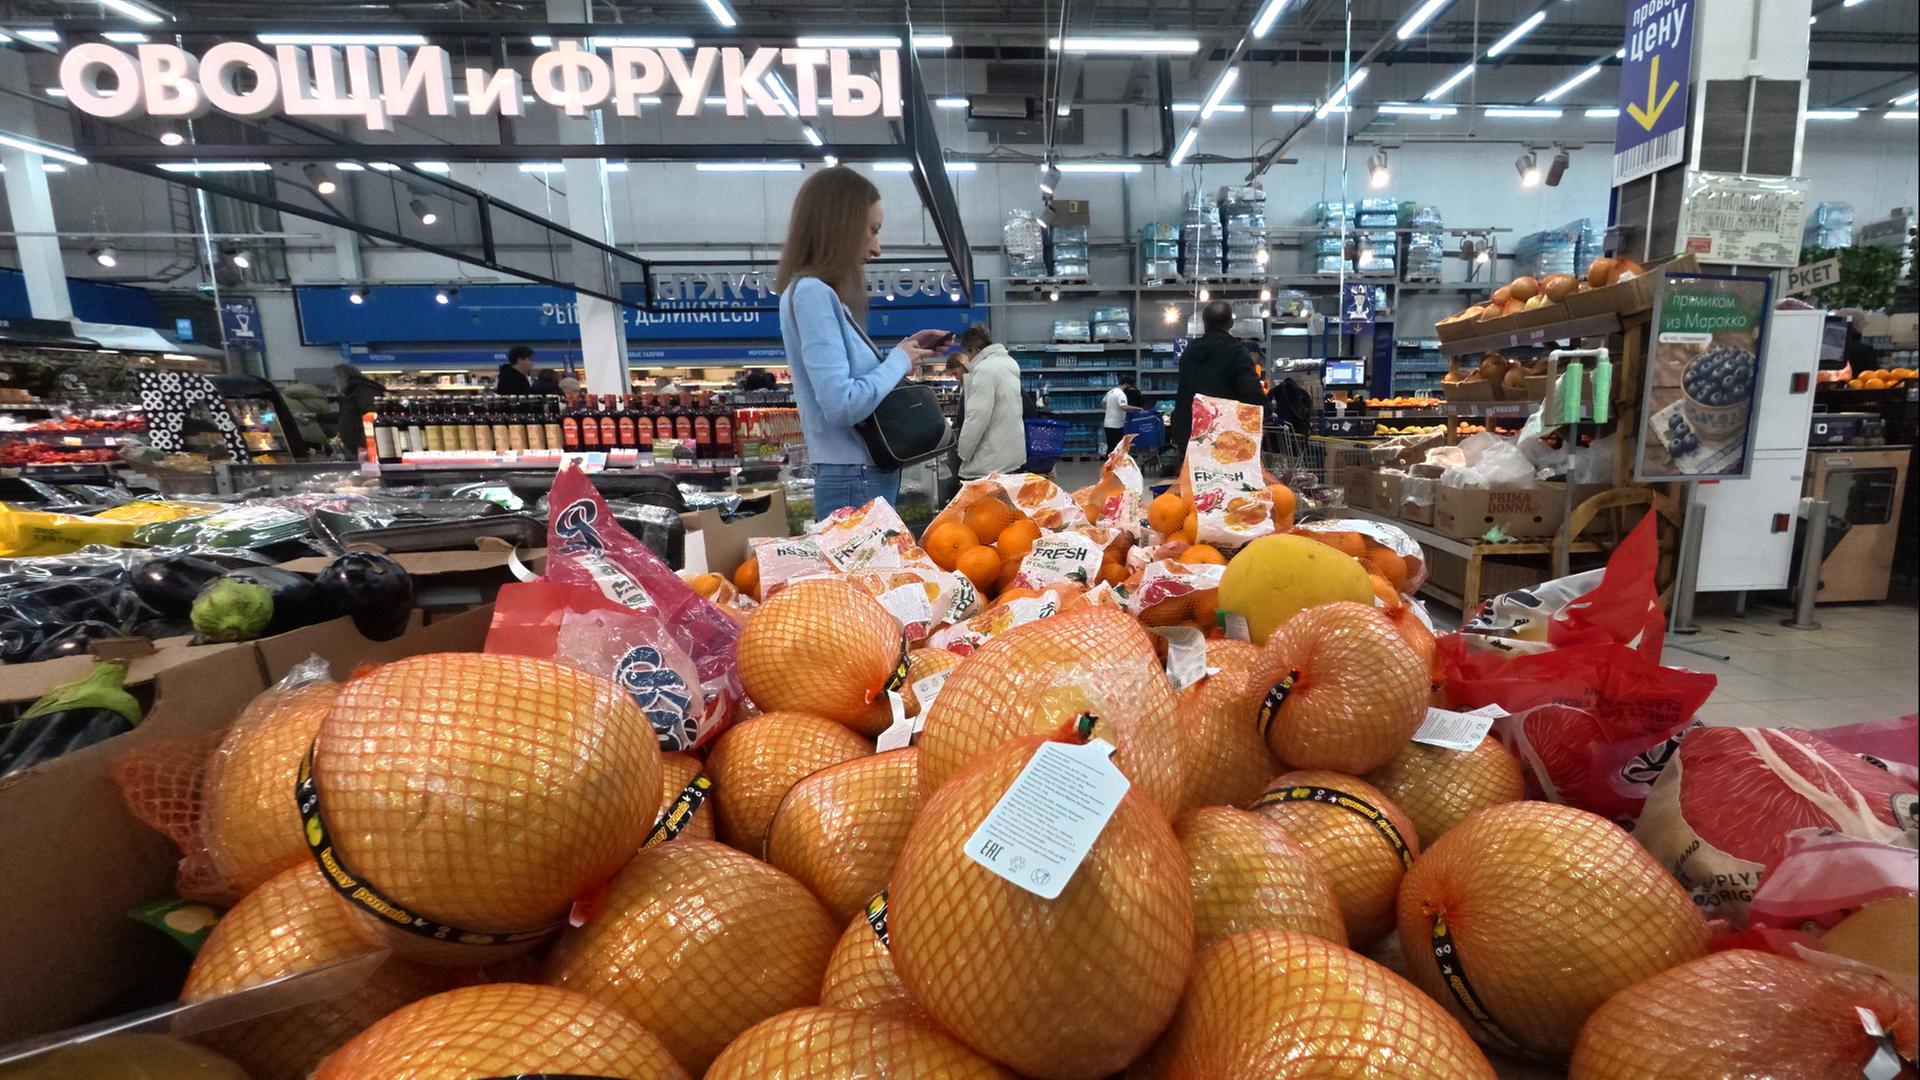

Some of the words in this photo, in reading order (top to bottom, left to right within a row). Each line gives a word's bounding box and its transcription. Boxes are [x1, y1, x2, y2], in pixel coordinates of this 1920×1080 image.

[1630, 3, 1687, 61] цену
[59, 42, 450, 131] ОВОЩИ
[466, 67, 523, 118] и
[531, 40, 902, 119] ФРУКТЫ
[1672, 295, 1736, 311] прямиком
[635, 301, 760, 327] ДЕЛИКАТЕСЫ
[1666, 318, 1680, 329] из
[1684, 312, 1747, 333] Марокко
[1489, 492, 1531, 503] PRIMA
[1488, 503, 1534, 514] DONNA
[1033, 547, 1088, 561] FRESH
[320, 847, 357, 889] honey
[352, 887, 413, 925] pomelo
